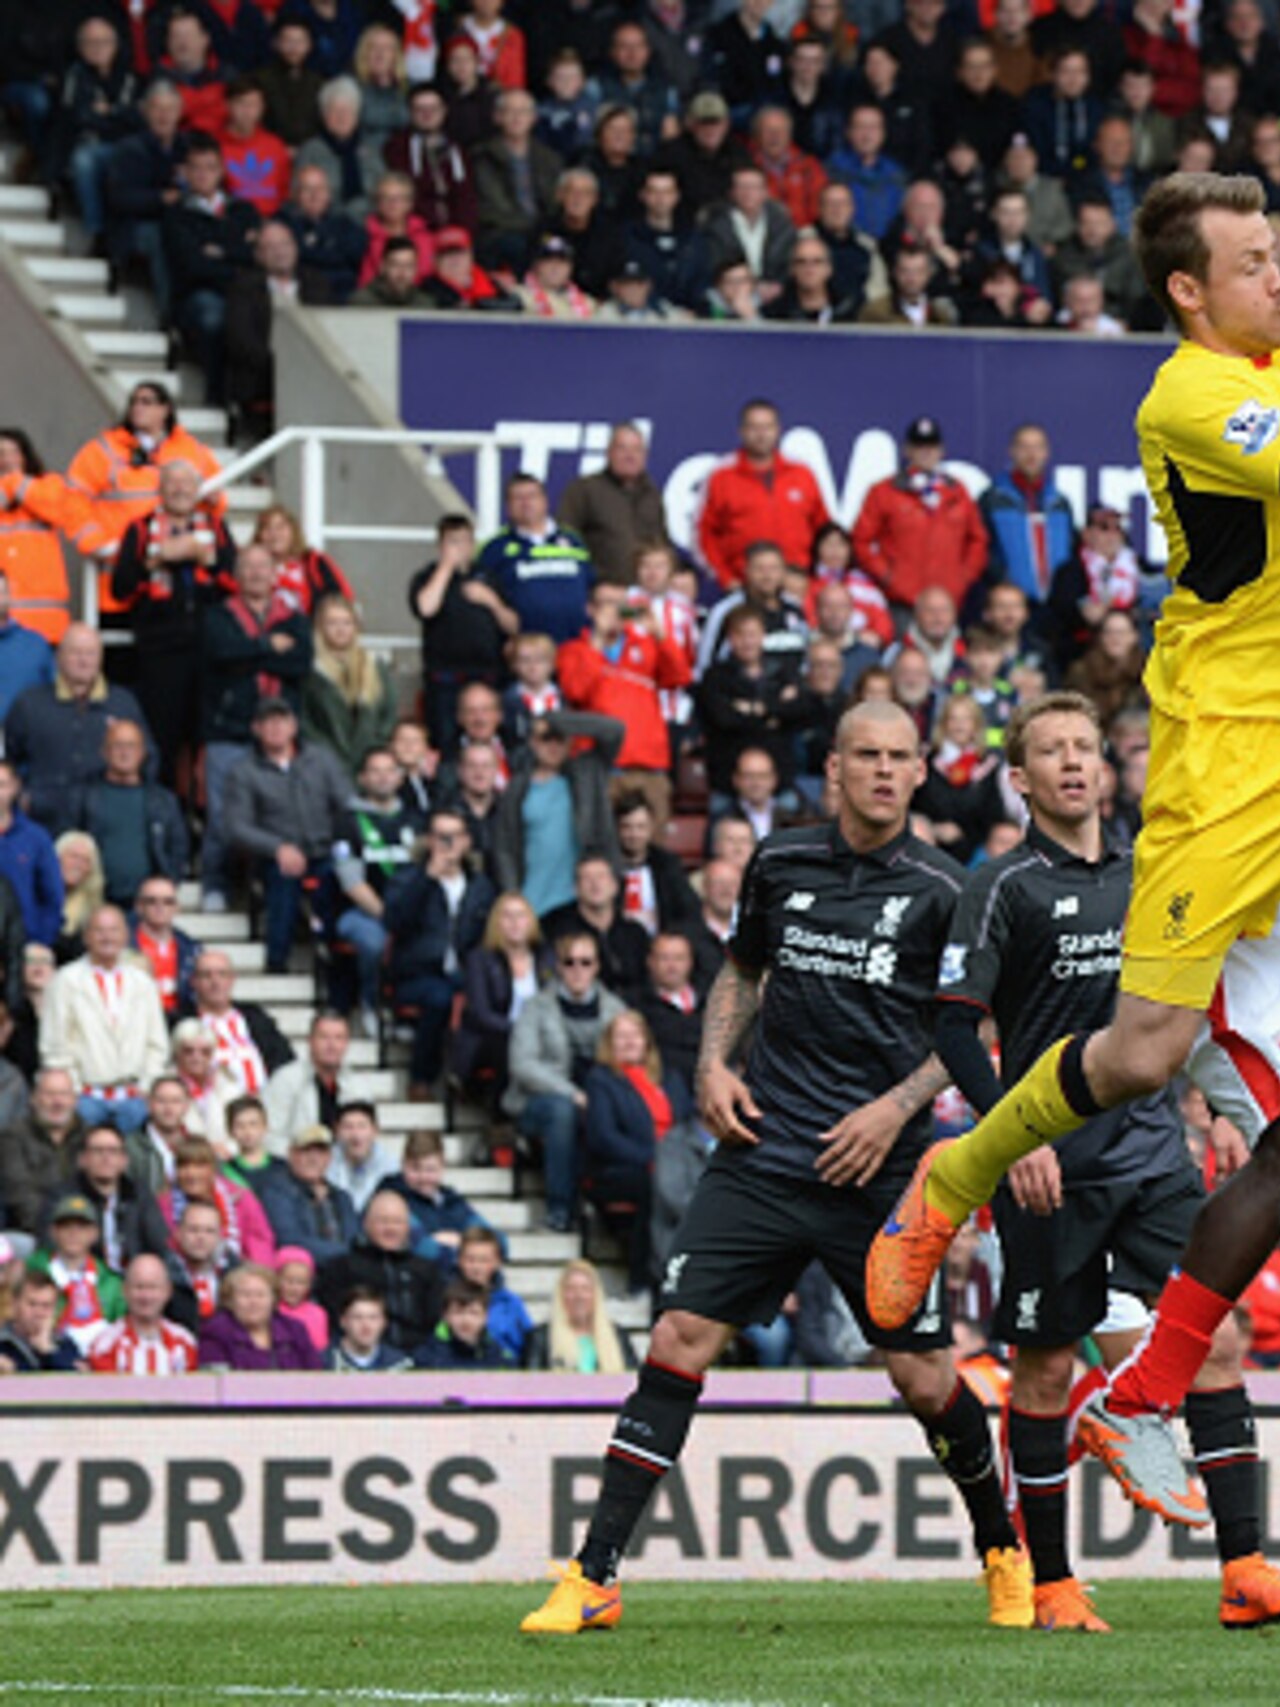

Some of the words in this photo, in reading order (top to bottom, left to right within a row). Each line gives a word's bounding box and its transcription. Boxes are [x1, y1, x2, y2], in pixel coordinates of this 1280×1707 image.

[783, 925, 867, 958] Standard
[777, 948, 863, 979] Chartered
[551, 1455, 961, 1560] PARCE
